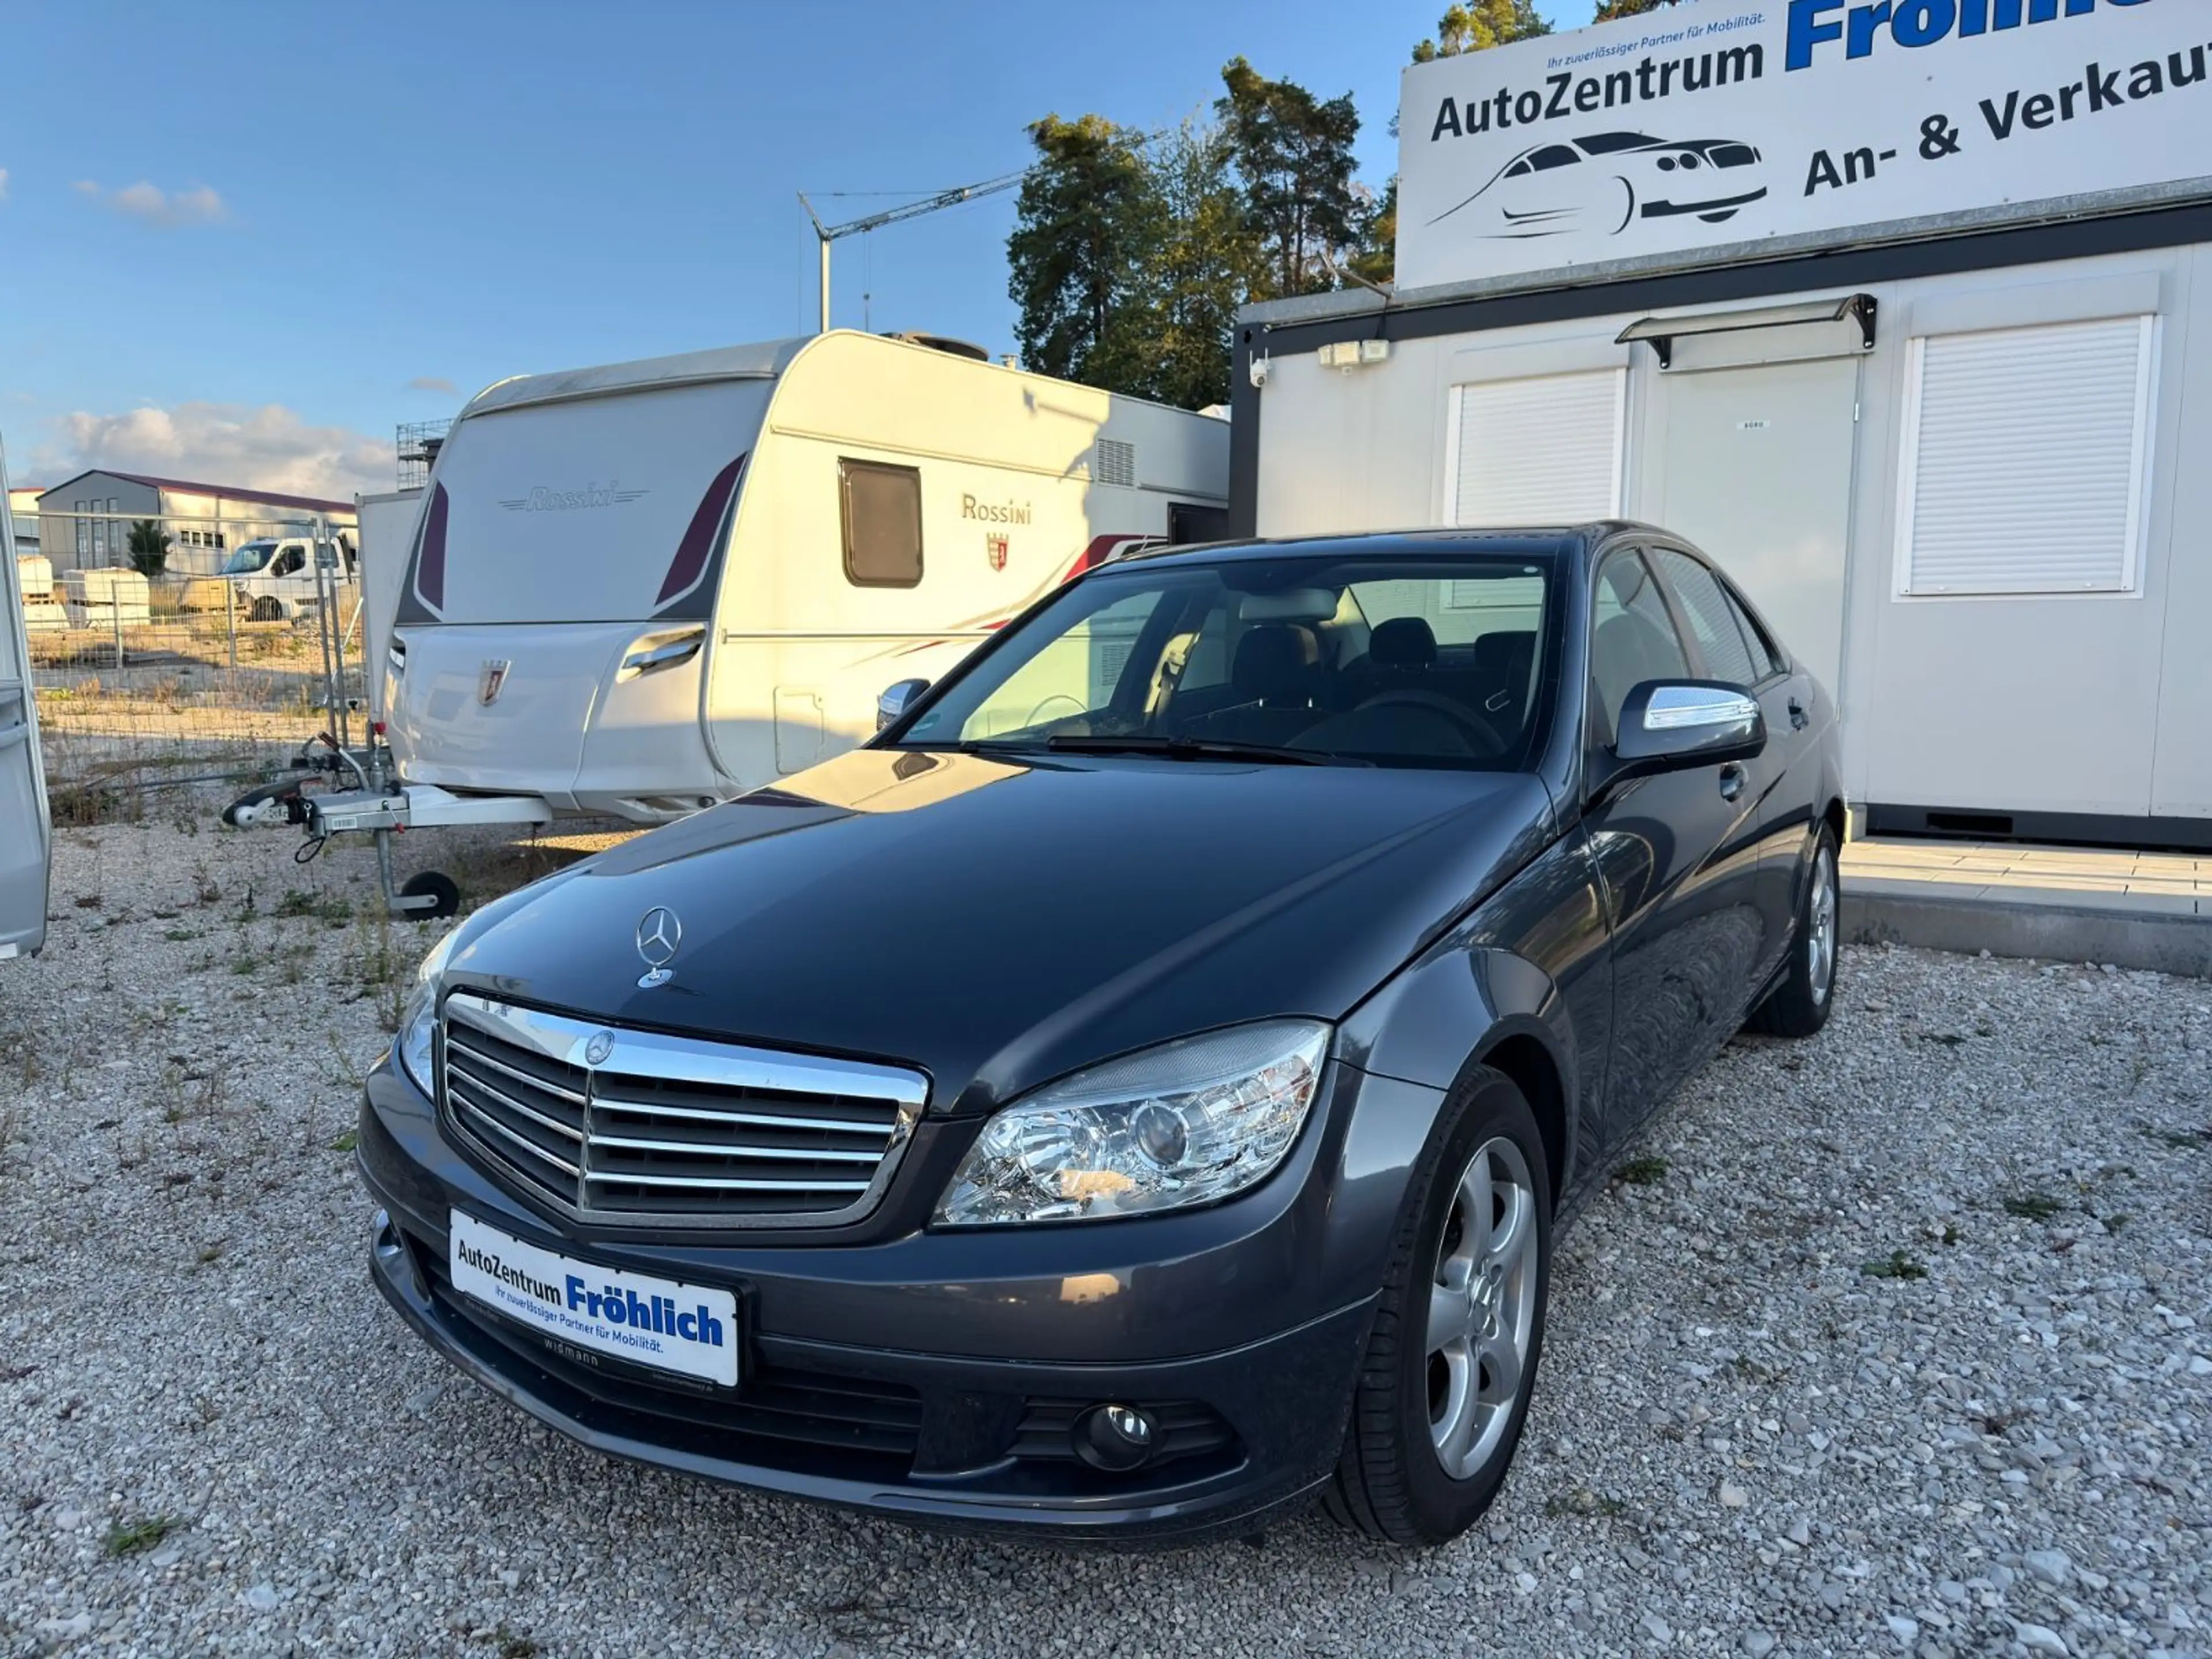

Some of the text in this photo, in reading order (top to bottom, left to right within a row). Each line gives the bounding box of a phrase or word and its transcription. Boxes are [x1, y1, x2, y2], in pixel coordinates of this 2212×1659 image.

[1547, 12, 1766, 69] Ihr zuverlässiger Partner für Mobilität.
[1430, 43, 1763, 142] AutoZentrum
[1804, 41, 2212, 198] An- & Verkau
[458, 1238, 724, 1347] AutoZentrum Fröhlich
[495, 1285, 505, 1298] Ihr
[506, 1293, 558, 1323] zuverlässiger
[559, 1313, 593, 1335] Partner
[595, 1325, 611, 1340] für
[612, 1330, 664, 1354] Mobilität.
